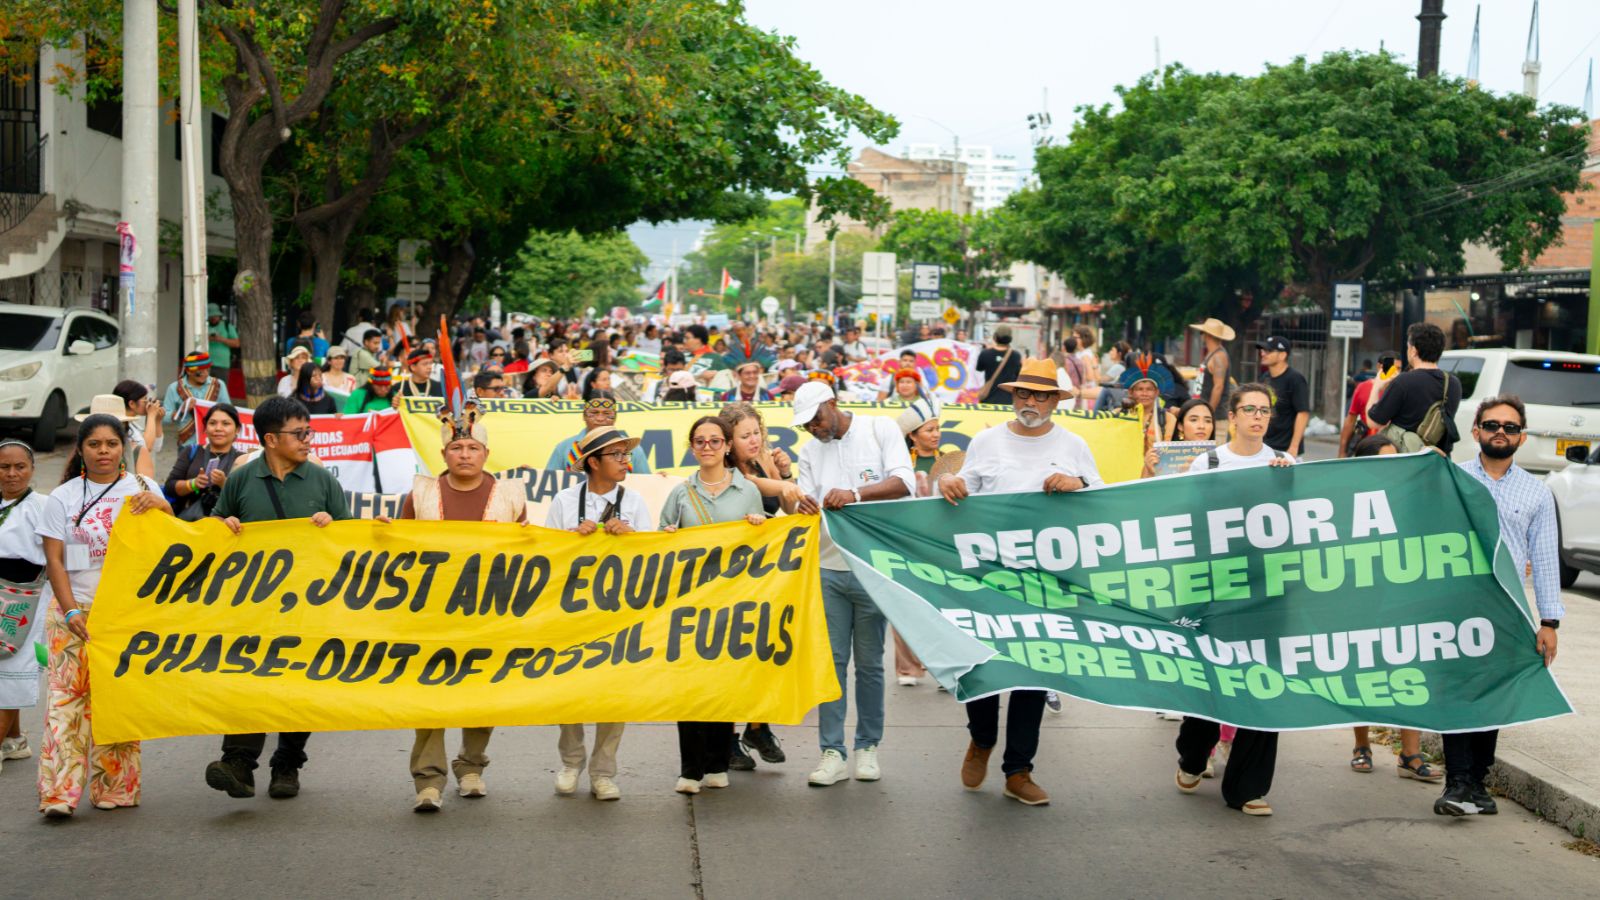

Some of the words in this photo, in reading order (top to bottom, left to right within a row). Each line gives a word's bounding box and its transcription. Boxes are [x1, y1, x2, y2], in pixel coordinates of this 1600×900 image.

[331, 442, 370, 456] ECUADOR
[954, 514, 1196, 572] PEOPLE
[1207, 497, 1339, 554] FOR
[1352, 490, 1397, 538] A
[137, 543, 298, 613] RAPID,
[306, 550, 450, 612] JUST
[445, 552, 550, 617] AND
[560, 525, 811, 613] EQUITABLE
[114, 631, 421, 684] PHASE-OUT
[417, 647, 492, 686] OF
[490, 620, 653, 684] FOSSIL
[666, 600, 794, 666] FUELS
[939, 608, 1080, 640] ENTE
[1082, 619, 1195, 658] POR
[1195, 635, 1268, 667] UN
[1279, 616, 1495, 675] FUTURO
[1140, 652, 1212, 692] DE
